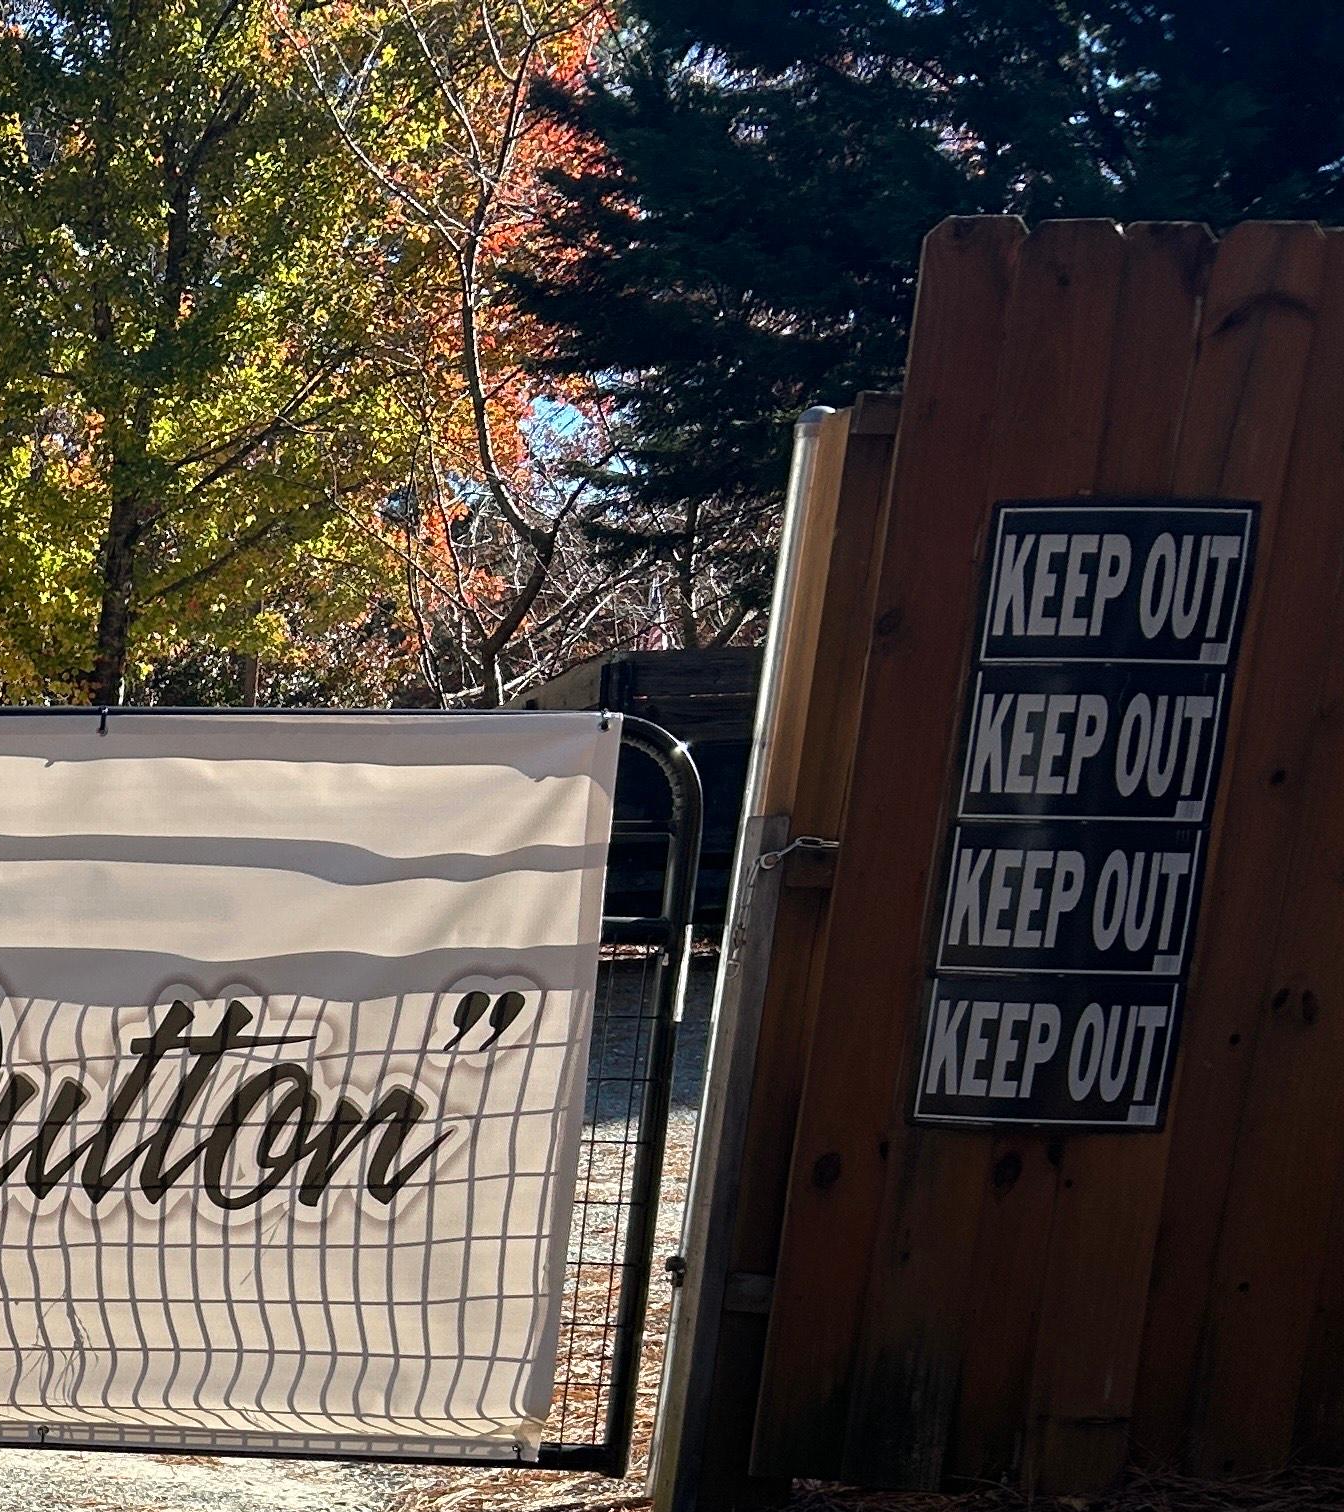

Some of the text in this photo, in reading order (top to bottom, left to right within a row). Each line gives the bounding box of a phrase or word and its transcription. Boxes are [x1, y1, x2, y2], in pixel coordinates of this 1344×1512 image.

[991, 532, 1241, 639] KEEP OUT
[969, 692, 1214, 798] KEEP OUT
[947, 848, 1191, 952] KEEP OUT
[925, 999, 1168, 1102] KEEP OUT
